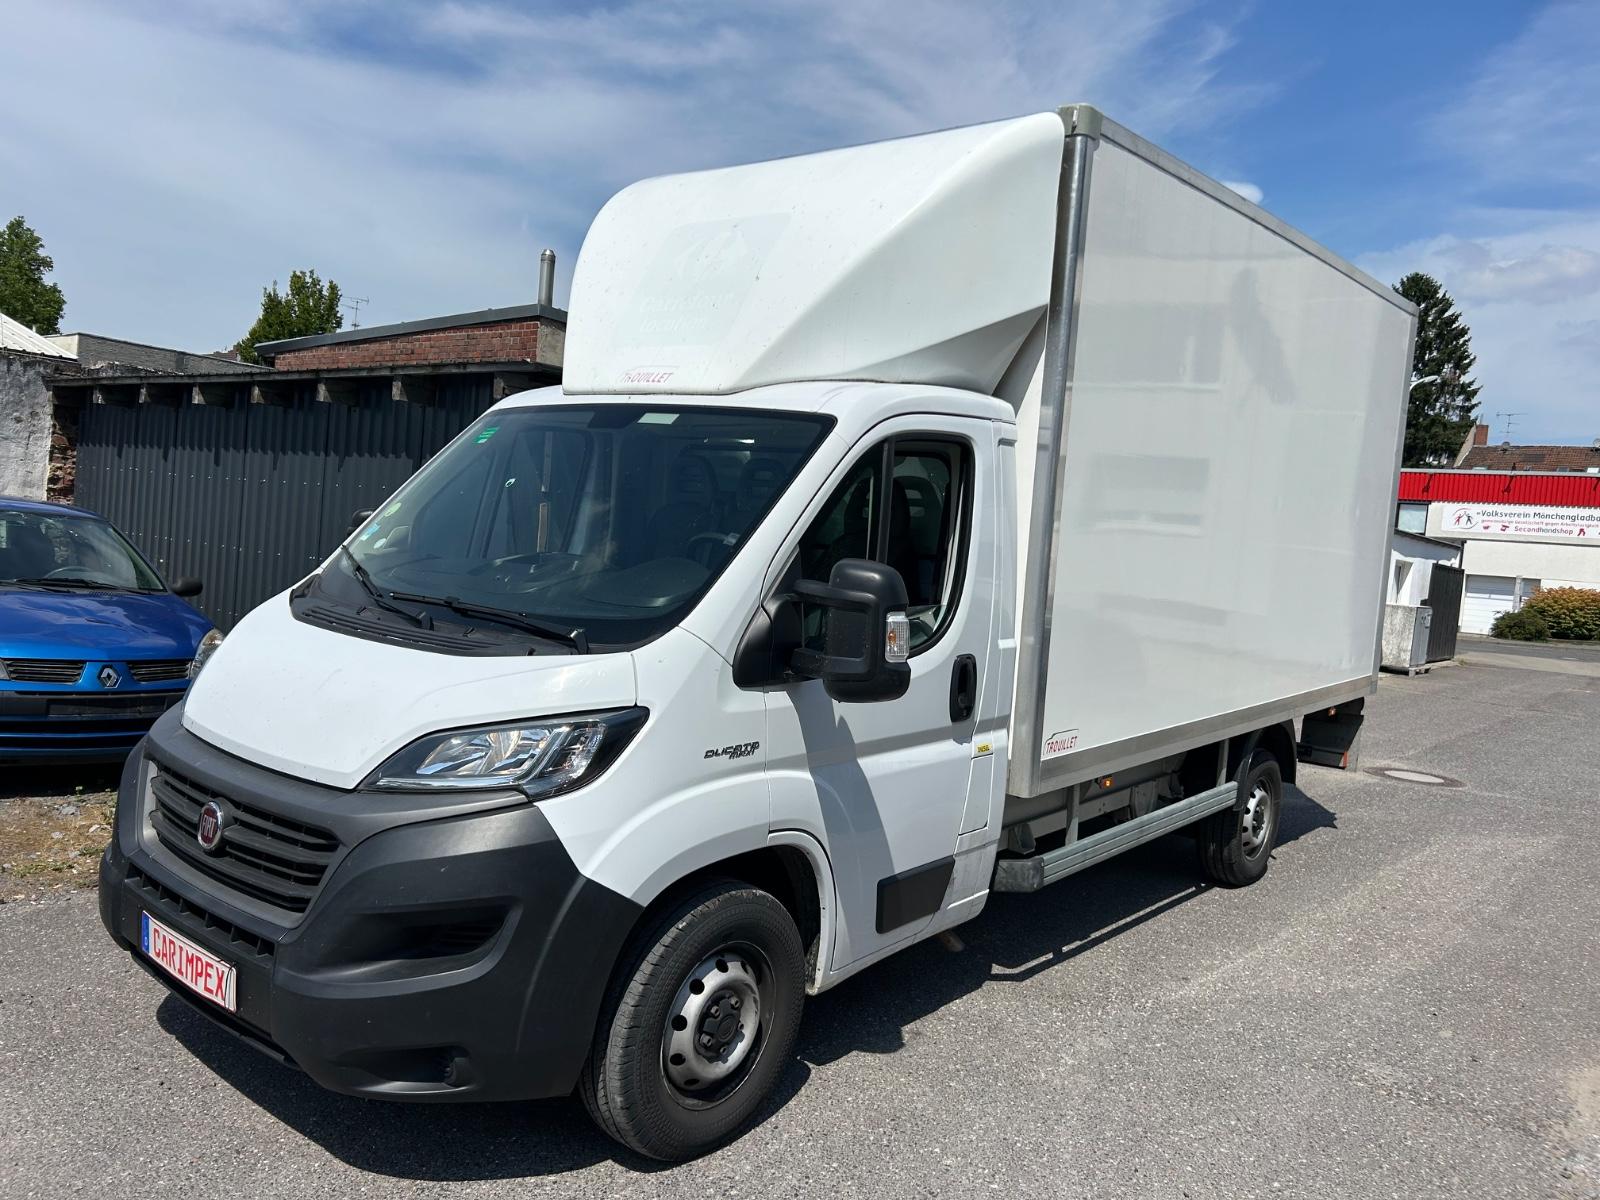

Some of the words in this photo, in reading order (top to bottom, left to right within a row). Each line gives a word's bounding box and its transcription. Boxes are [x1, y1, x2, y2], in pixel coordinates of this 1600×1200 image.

[1481, 510, 1531, 519] Volksverein
[1514, 525, 1574, 536] Secondhandshop
[704, 740, 760, 759] DUCATO
[1046, 735, 1078, 755] TROUILLET
[202, 814, 217, 838] FIAT
[153, 927, 225, 1001] CARIMPEX
